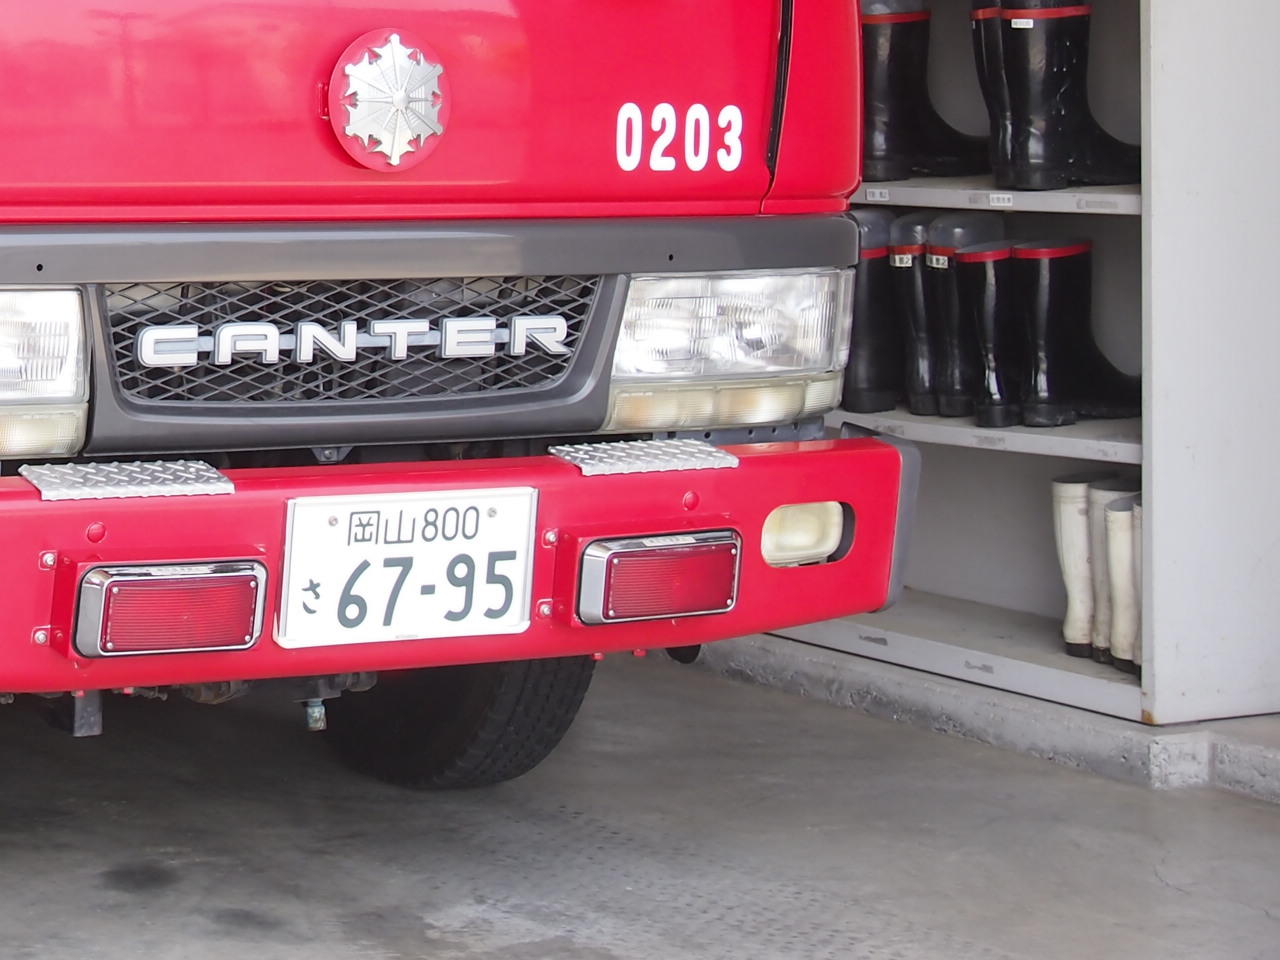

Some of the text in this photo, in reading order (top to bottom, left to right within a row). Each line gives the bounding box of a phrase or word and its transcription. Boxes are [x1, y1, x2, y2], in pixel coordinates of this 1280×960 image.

[615, 102, 745, 172] 0203
[140, 314, 572, 367] CANTER
[301, 550, 517, 628] さ 67-95
